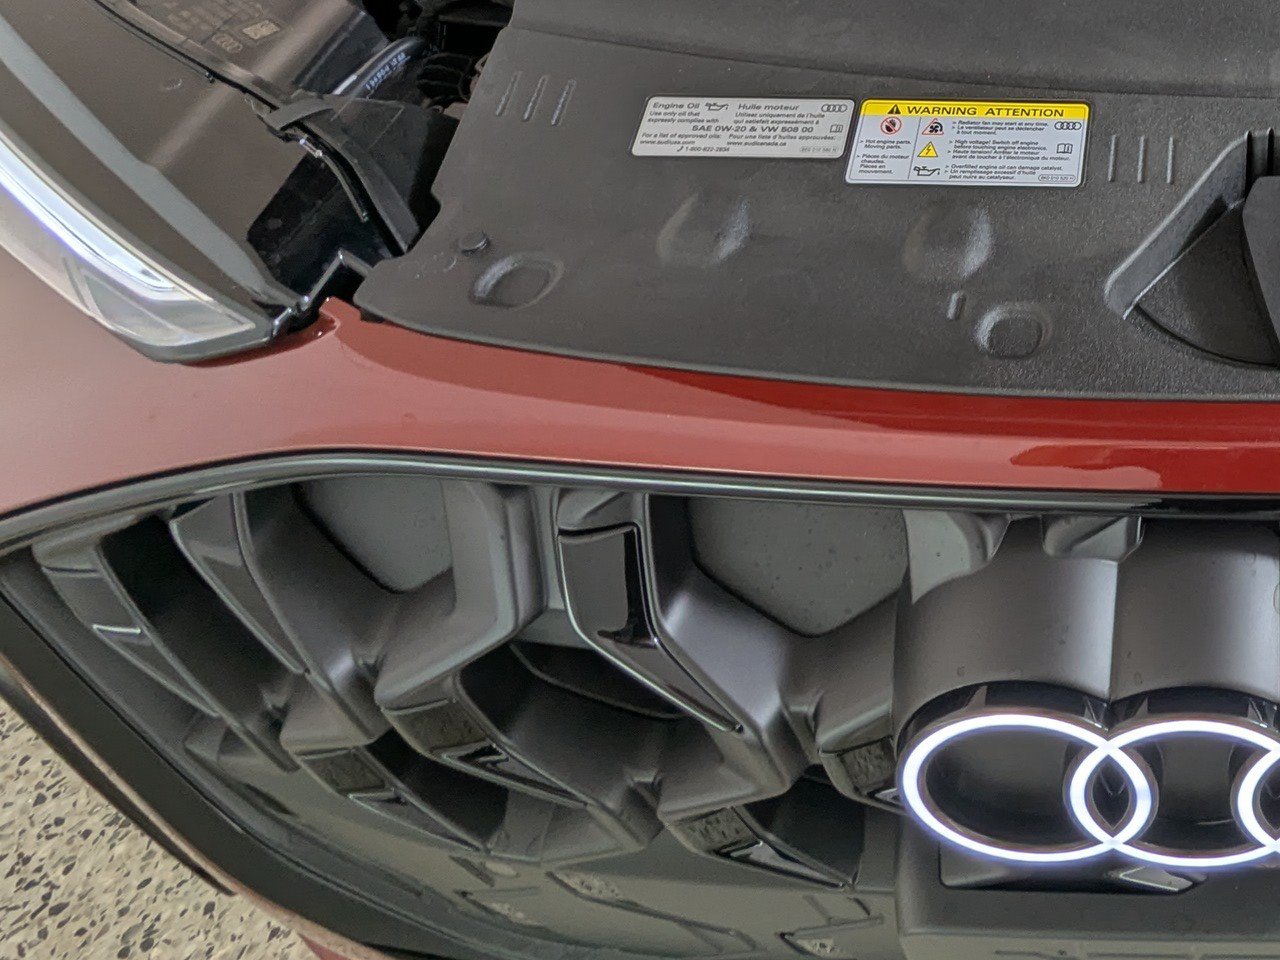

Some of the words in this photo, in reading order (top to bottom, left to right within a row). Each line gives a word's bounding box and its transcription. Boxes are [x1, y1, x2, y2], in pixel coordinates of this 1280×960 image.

[653, 102, 684, 110] Engine
[908, 106, 977, 115] WARNING
[985, 107, 1064, 117] ATTENTION
